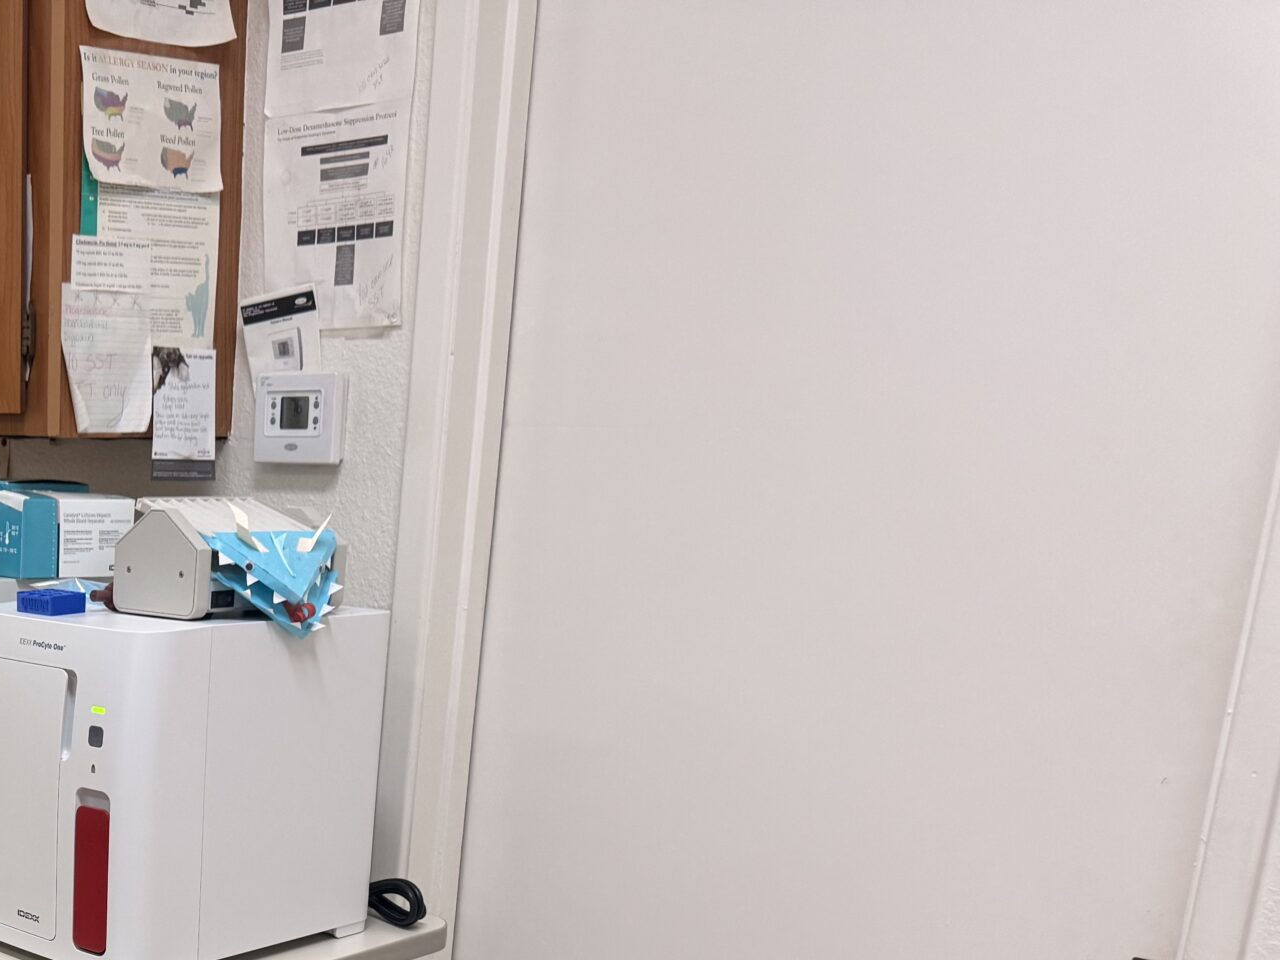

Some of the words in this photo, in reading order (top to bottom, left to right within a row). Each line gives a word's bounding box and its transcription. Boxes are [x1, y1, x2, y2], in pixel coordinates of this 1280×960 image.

[97, 54, 135, 68] ALLERGY
[136, 60, 168, 73] SEASON
[170, 64, 177, 75] in
[178, 67, 193, 78] your
[194, 70, 217, 80] region?
[92, 72, 110, 82] Grass
[110, 74, 129, 86] Pollen
[157, 81, 183, 93] Ragweed
[184, 84, 203, 95] Pollen
[91, 126, 104, 137] Tree
[106, 127, 125, 139] Pollen
[160, 134, 177, 145] Weed
[177, 135, 196, 147] Pollen
[33, 640, 52, 650] ProCyte
[18, 909, 39, 923] IDEXX
